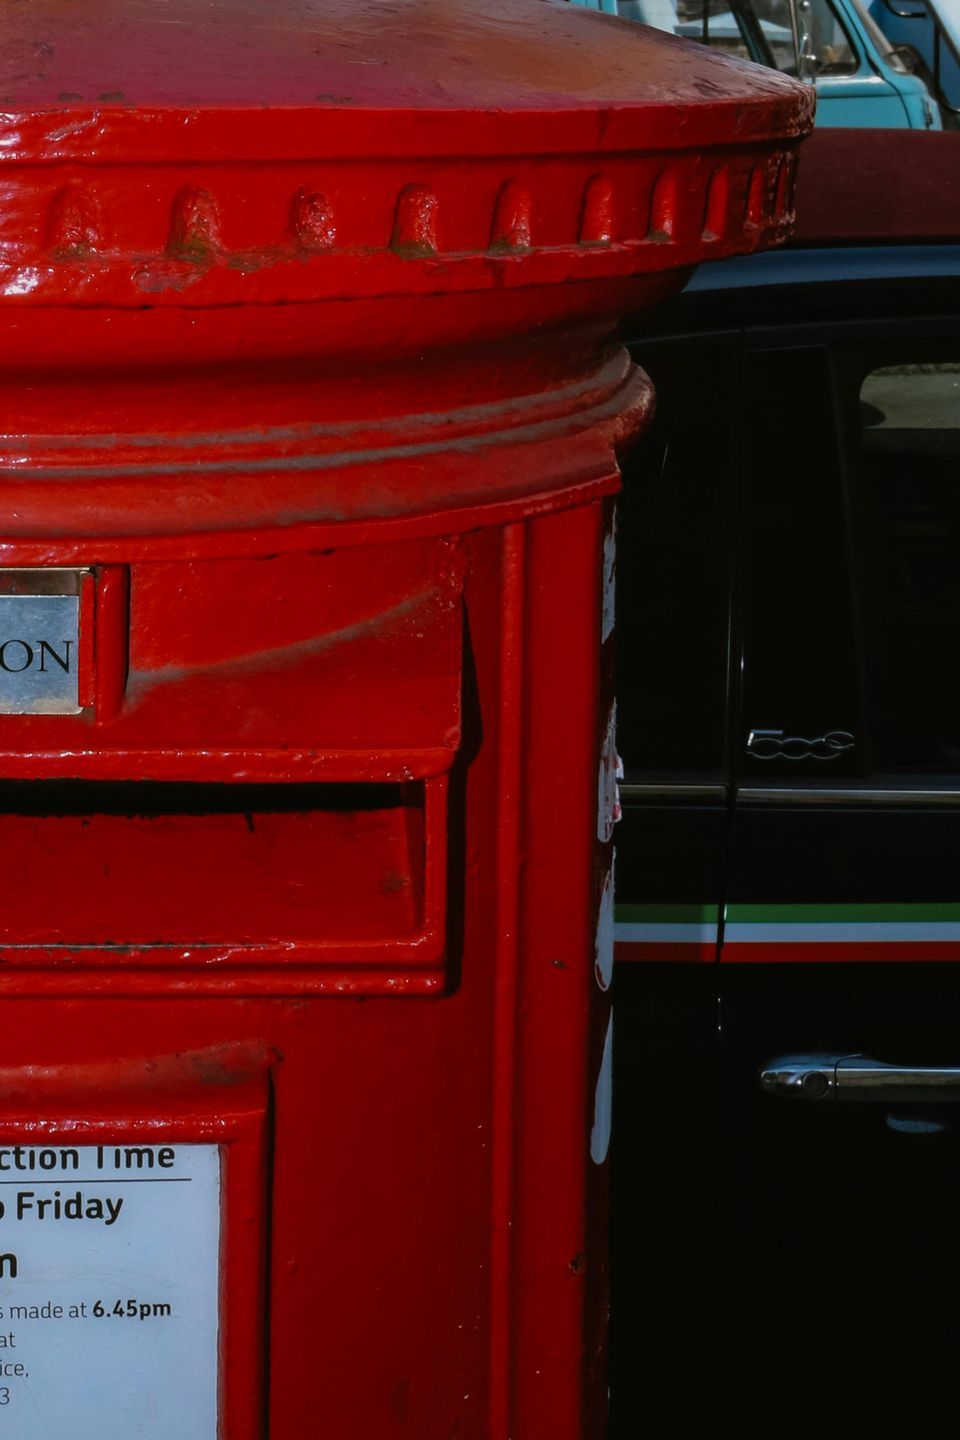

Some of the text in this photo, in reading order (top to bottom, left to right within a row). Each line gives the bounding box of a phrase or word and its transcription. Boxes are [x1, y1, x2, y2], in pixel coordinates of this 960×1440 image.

[17, 1190, 124, 1226] Friday
[10, 1300, 64, 1320] made
[68, 1302, 88, 1318] at
[92, 1299, 171, 1321] 6.45pm
